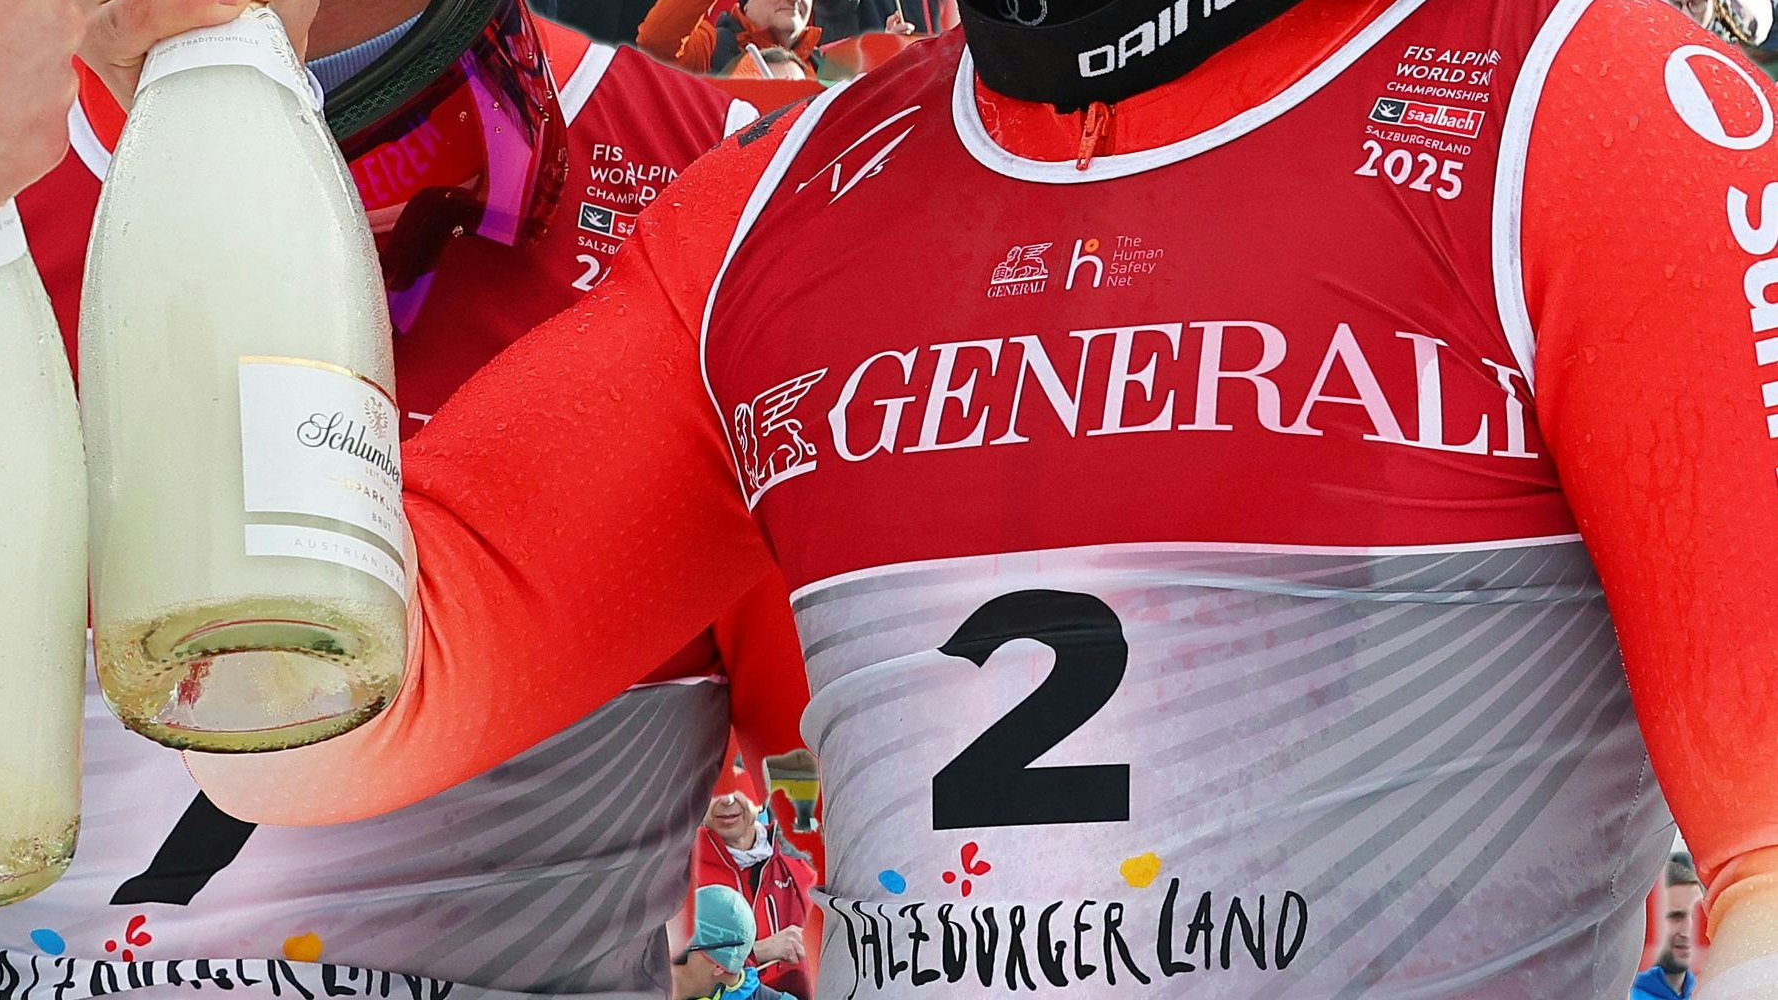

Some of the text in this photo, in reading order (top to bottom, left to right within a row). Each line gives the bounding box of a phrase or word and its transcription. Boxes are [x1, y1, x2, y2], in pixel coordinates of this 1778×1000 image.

[1403, 45, 1502, 67] FIS ALPINE
[1395, 62, 1466, 84] WORLD
[1386, 81, 1490, 103] CHAMPIONSHIPS
[1406, 106, 1476, 131] saalbach
[1364, 125, 1472, 156] SALZBURGERLAND
[592, 144, 624, 161] FIS
[1353, 139, 1464, 200] 2025
[1116, 235, 1143, 248] The
[1112, 246, 1165, 262] Human
[1109, 261, 1157, 276] Safety
[986, 280, 1047, 299] GENERALI
[1106, 274, 1134, 288] Net
[827, 318, 1539, 463] GENERALI
[371, 511, 393, 533] BRUT
[294, 536, 379, 568] AUSTRIAN
[931, 588, 1131, 831] 2
[829, 877, 1310, 1000] SALZBURGER LAND
